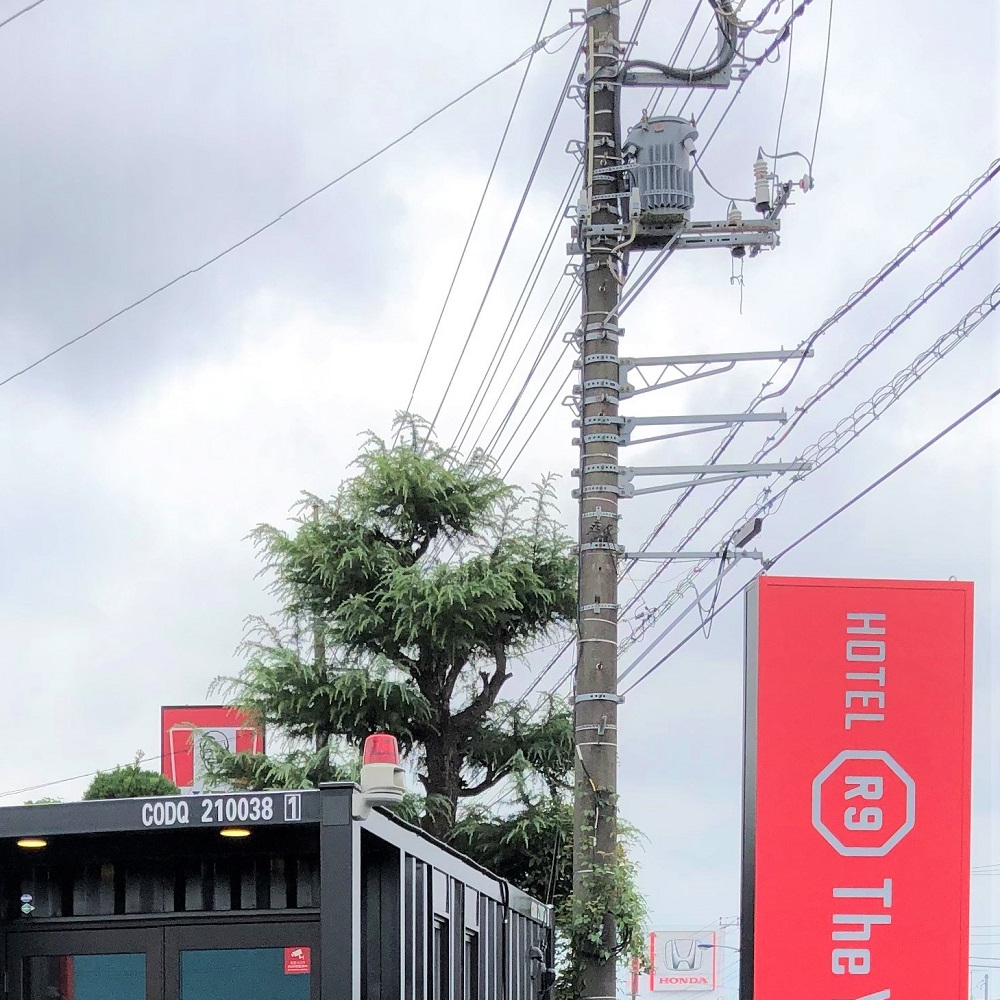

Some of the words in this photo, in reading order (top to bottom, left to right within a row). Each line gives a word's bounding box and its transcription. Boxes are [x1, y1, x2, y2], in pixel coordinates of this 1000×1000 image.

[844, 611, 887, 731] HOTEL
[142, 800, 190, 827] CODQ
[201, 796, 273, 822] 210038
[286, 795, 299, 820] 1
[843, 775, 884, 832] R9
[831, 878, 892, 975] The
[659, 977, 708, 985] HONDA
